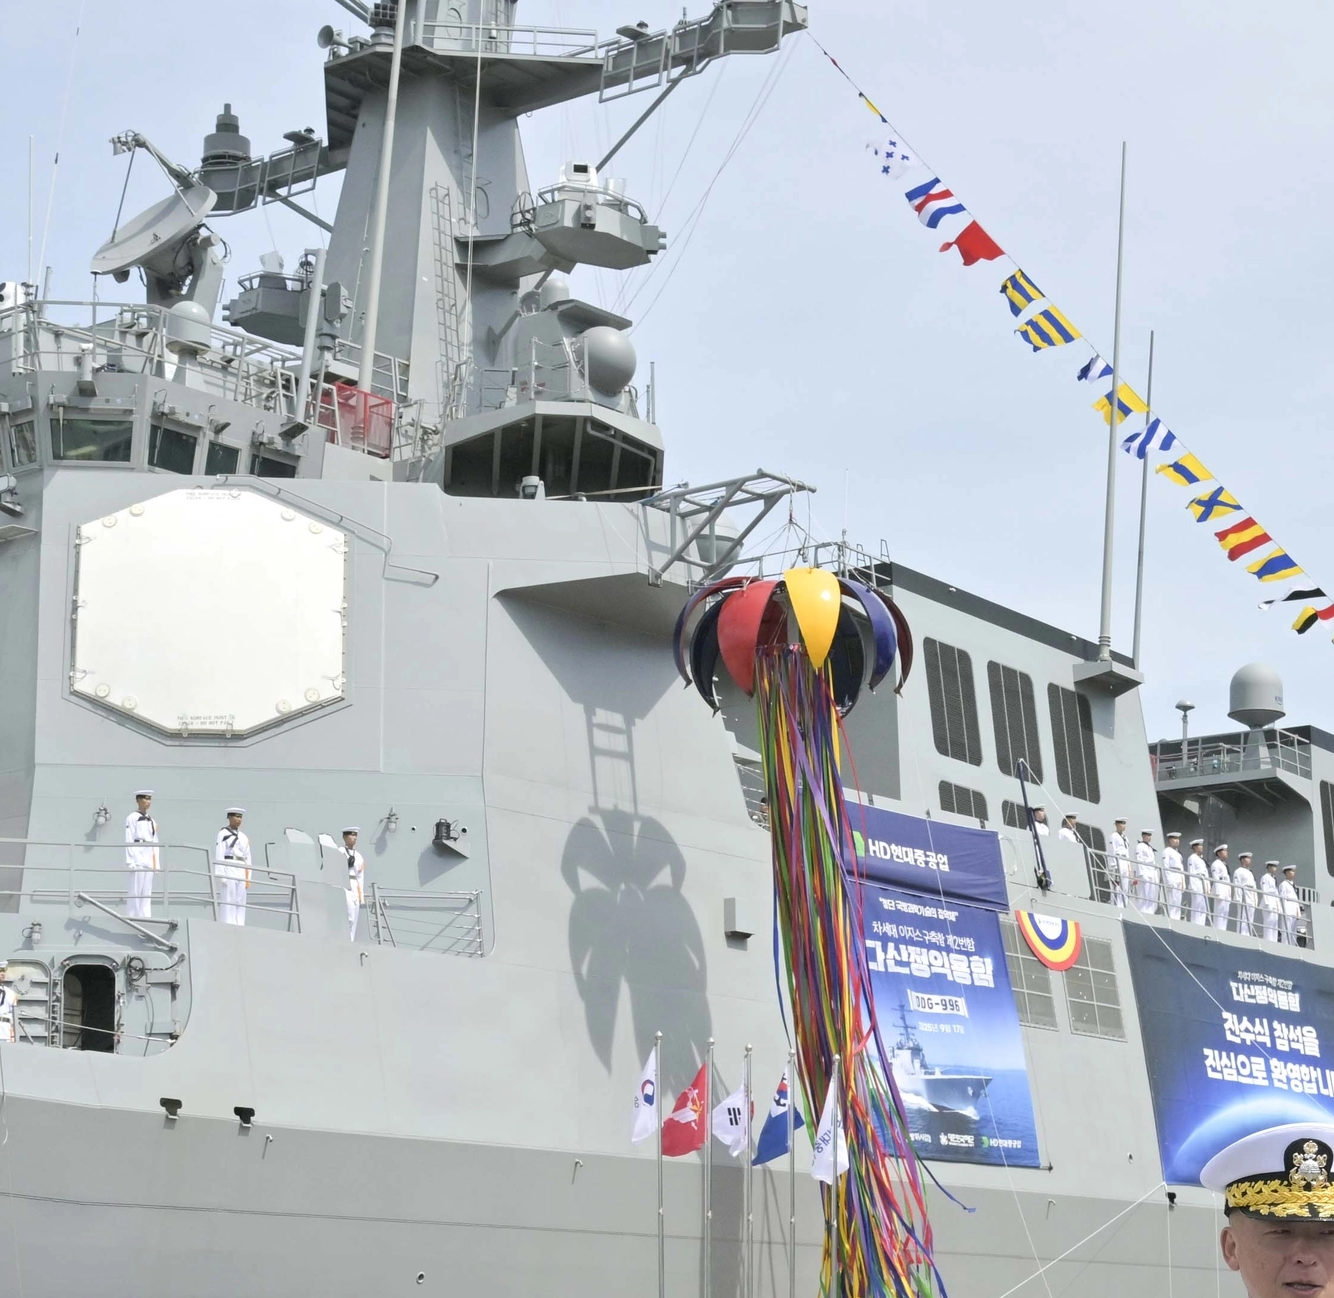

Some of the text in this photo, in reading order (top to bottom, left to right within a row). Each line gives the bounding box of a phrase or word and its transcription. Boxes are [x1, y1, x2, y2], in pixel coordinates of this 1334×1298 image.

[868, 838, 950, 872] HD현대중공업
[872, 921, 898, 938] 차세대
[915, 995, 961, 1012] DDG-996
[1222, 1011, 1320, 1058] 진수식 참석을
[1203, 1047, 1269, 1087] 진심으로
